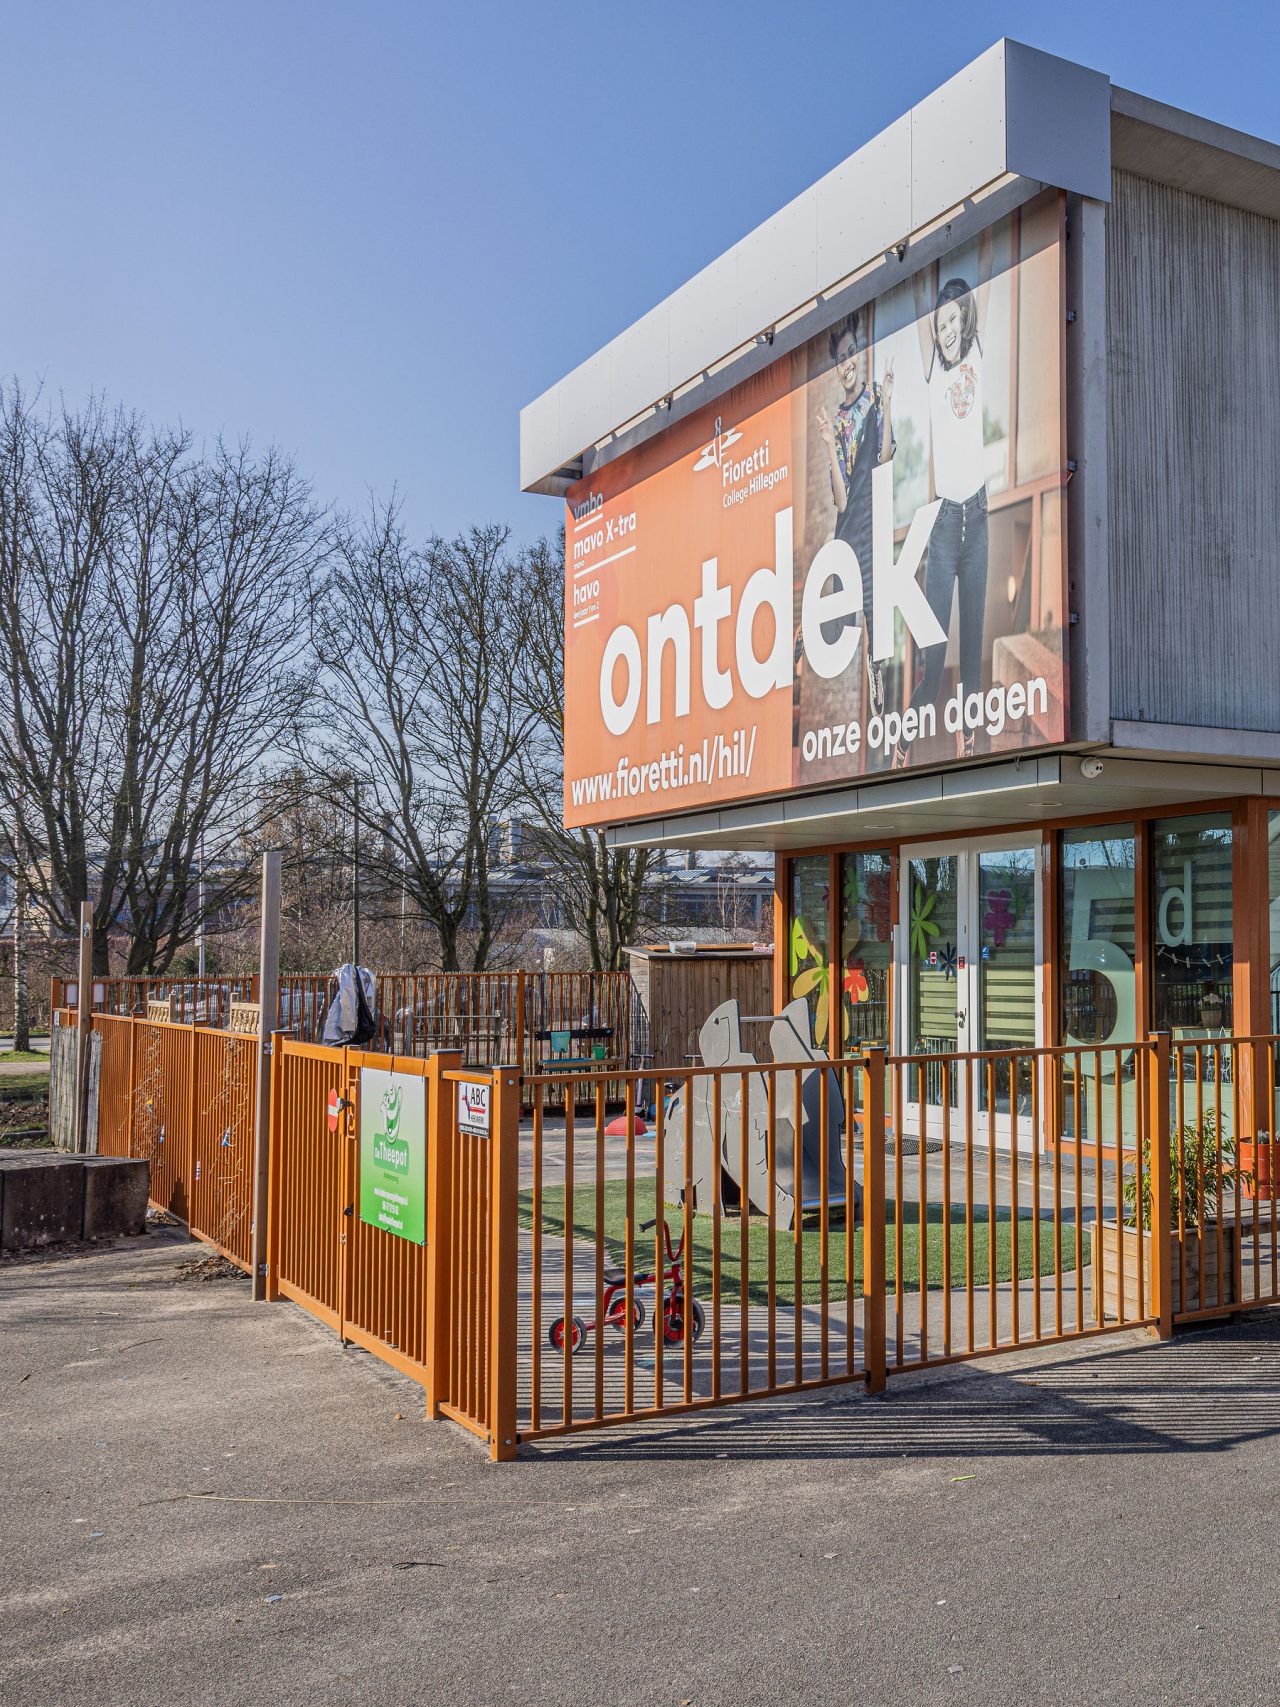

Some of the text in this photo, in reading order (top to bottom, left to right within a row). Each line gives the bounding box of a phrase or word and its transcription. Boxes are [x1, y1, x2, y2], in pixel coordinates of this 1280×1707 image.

[722, 464, 788, 508] College Hillegom
[723, 439, 769, 488] Fioretti
[574, 491, 604, 523] vmbo
[573, 511, 637, 560] mavo X-tra
[573, 579, 600, 607] havo
[599, 459, 949, 736] ontdek
[802, 676, 1048, 762] onze open dagen
[571, 725, 758, 807] www.fioretti.nl/hil/
[470, 1087, 486, 1107] ABC
[379, 1140, 408, 1169] Theepot
